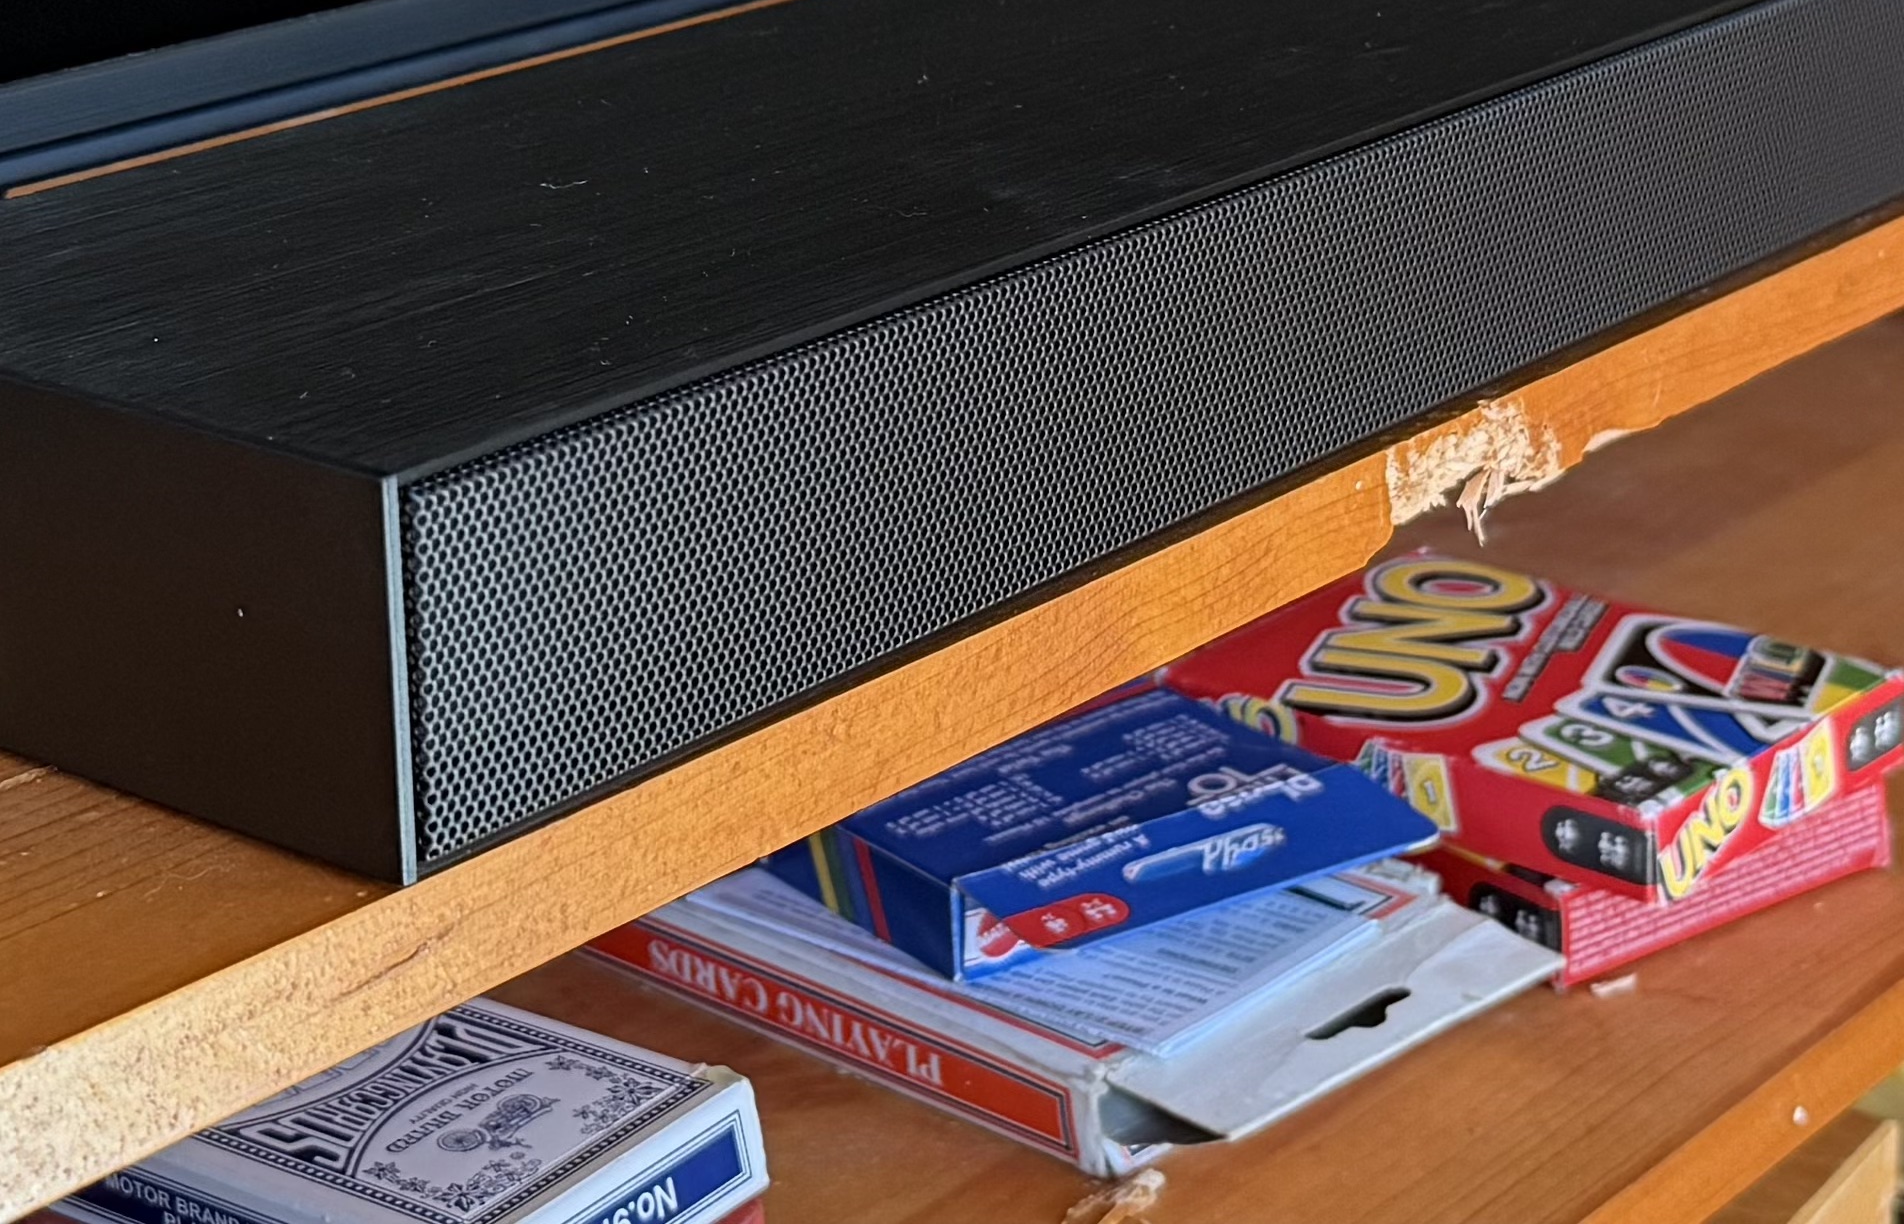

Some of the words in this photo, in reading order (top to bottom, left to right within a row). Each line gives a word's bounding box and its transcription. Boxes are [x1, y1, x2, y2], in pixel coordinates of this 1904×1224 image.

[1280, 558, 1554, 726] UNO
[1507, 746, 1559, 774] 2
[1659, 767, 1754, 901] UNO
[647, 939, 768, 1015] CARDS
[777, 991, 944, 1086] PLAYING
[408, 1095, 454, 1124] QUALITY
